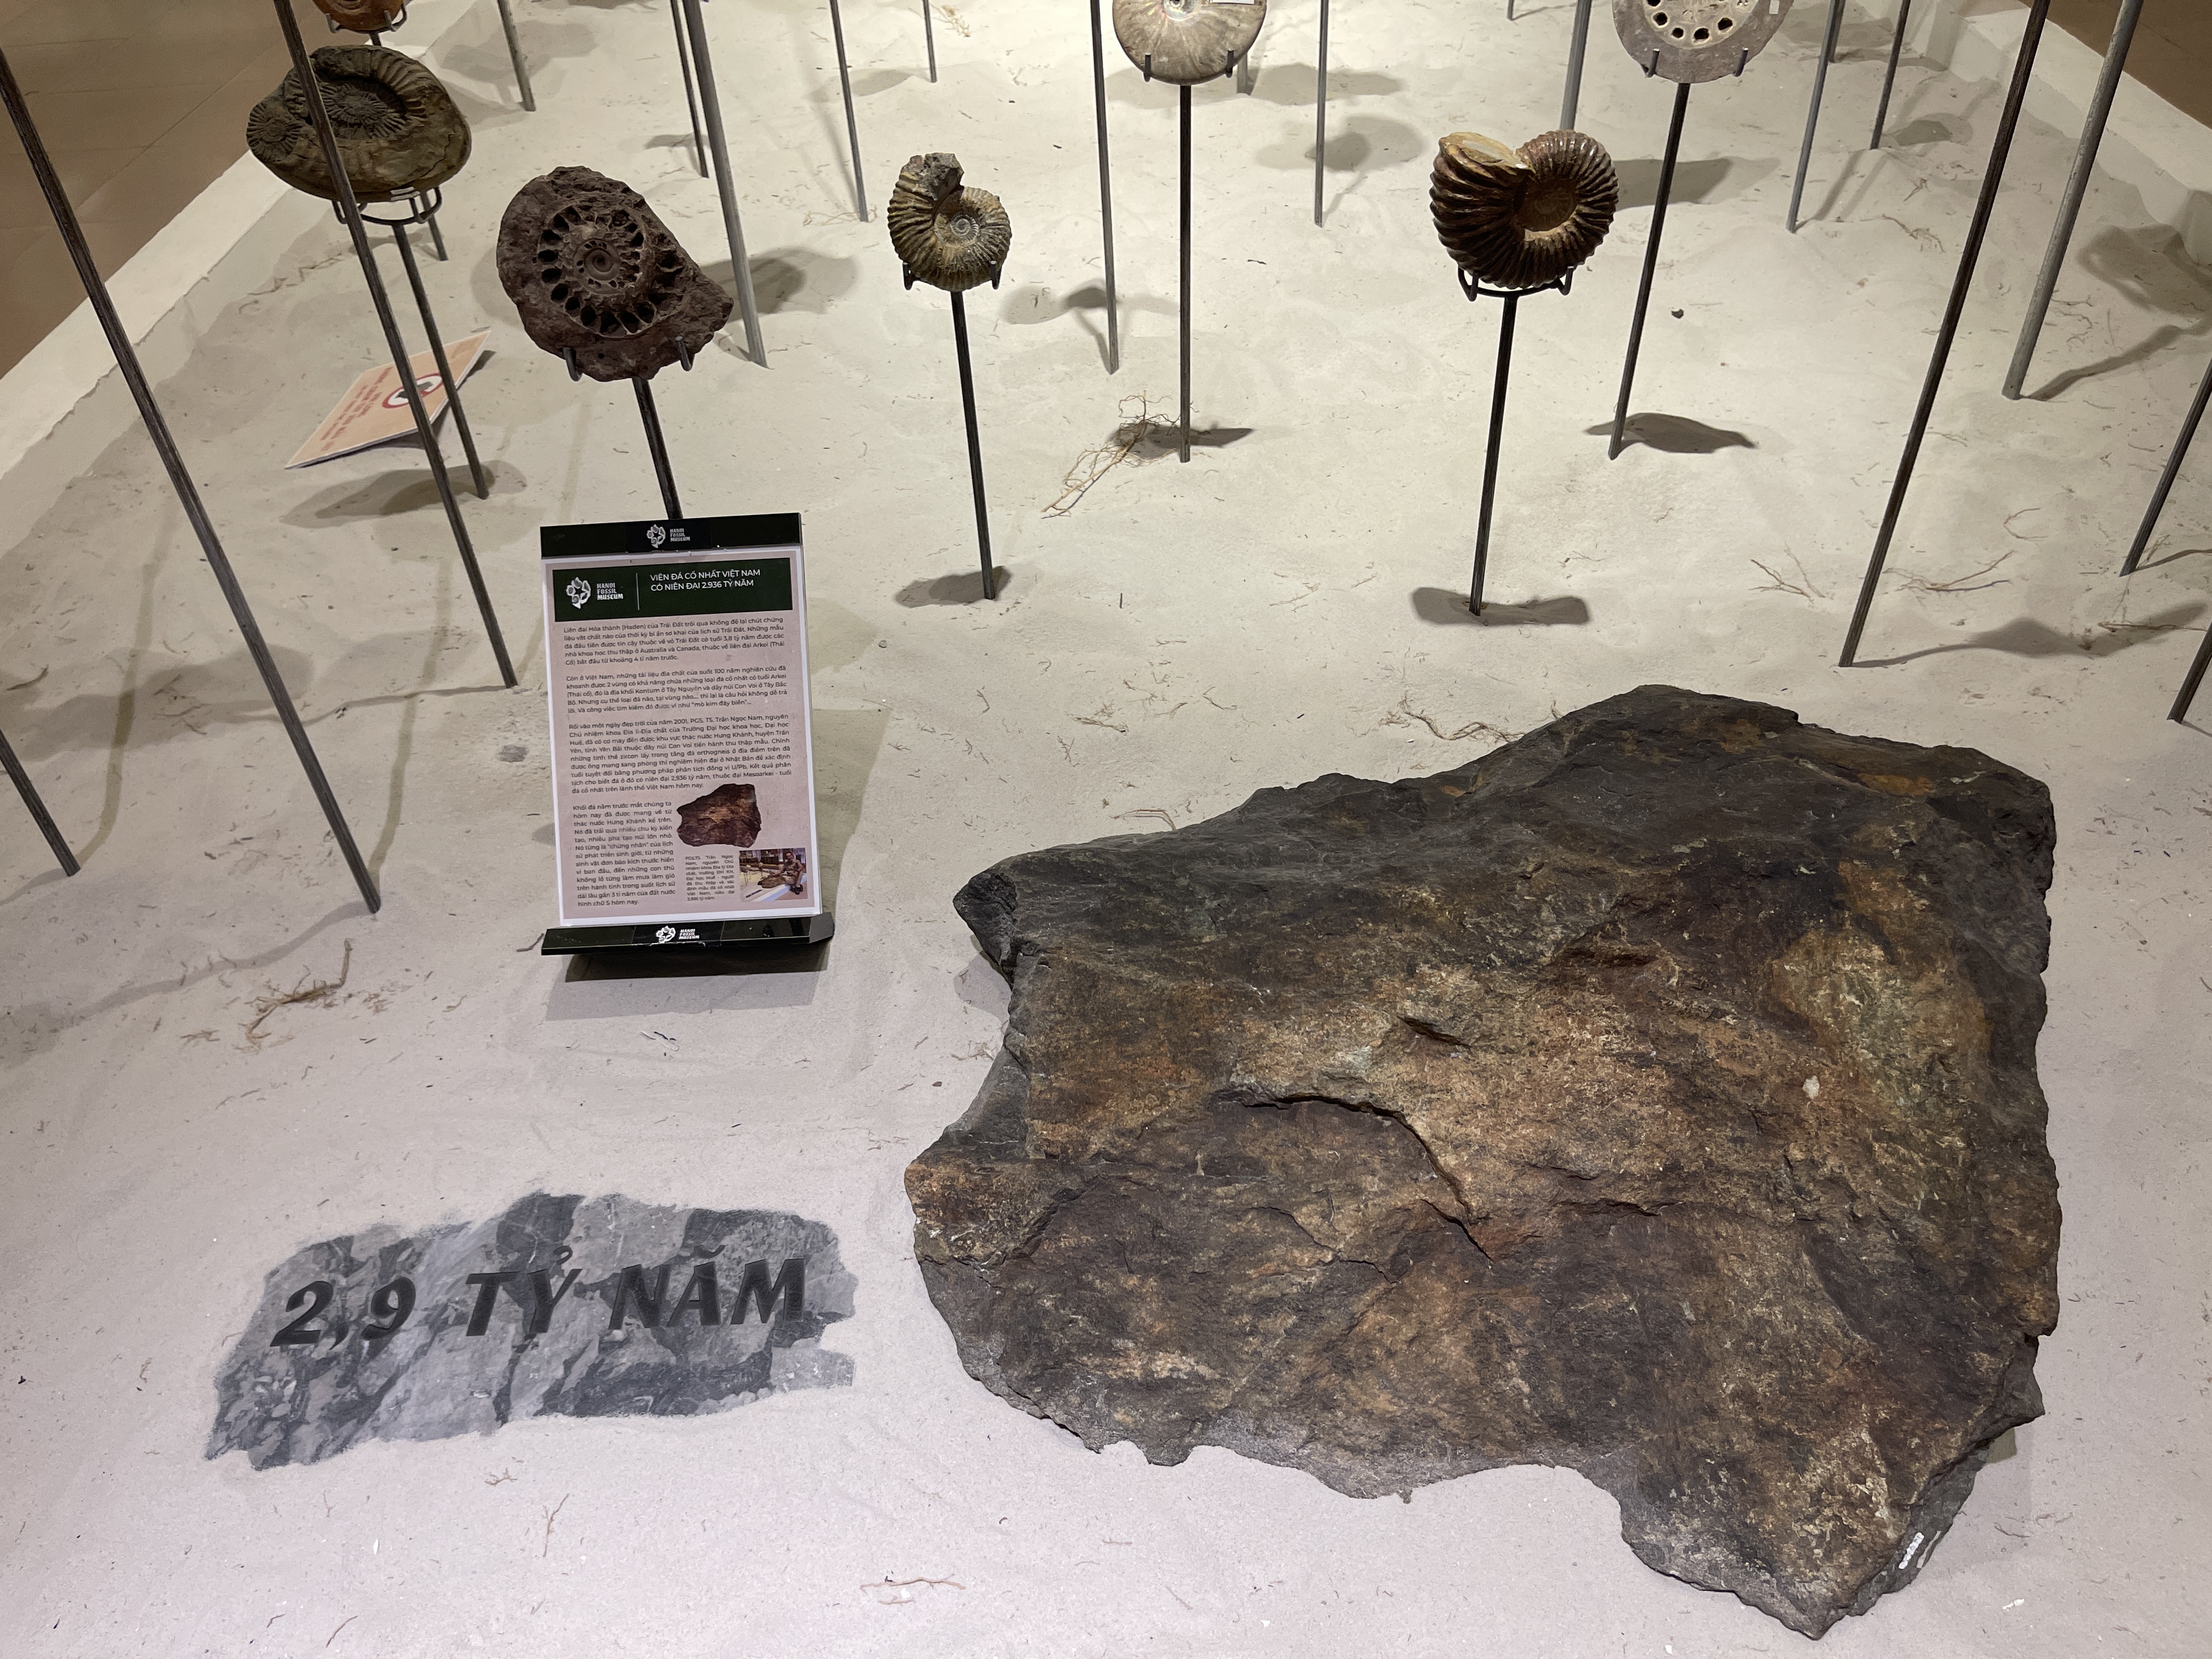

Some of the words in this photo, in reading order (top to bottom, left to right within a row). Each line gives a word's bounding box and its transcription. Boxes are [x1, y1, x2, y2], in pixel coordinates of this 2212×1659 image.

[650, 573, 669, 582] VIÊN
[671, 572, 684, 581] ĐÁ
[684, 570, 697, 579] CỔ
[698, 569, 721, 579] NHẤT
[722, 569, 740, 578] VIỆT
[651, 582, 663, 591] CÓ
[664, 582, 684, 591] NIÊN
[686, 582, 700, 591] ĐẠI
[723, 579, 733, 588] TỶ
[735, 578, 754, 587] NĂM
[269, 1276, 416, 1350] 2,9
[465, 1245, 583, 1336] TỶ
[608, 1245, 805, 1330] NĂM
